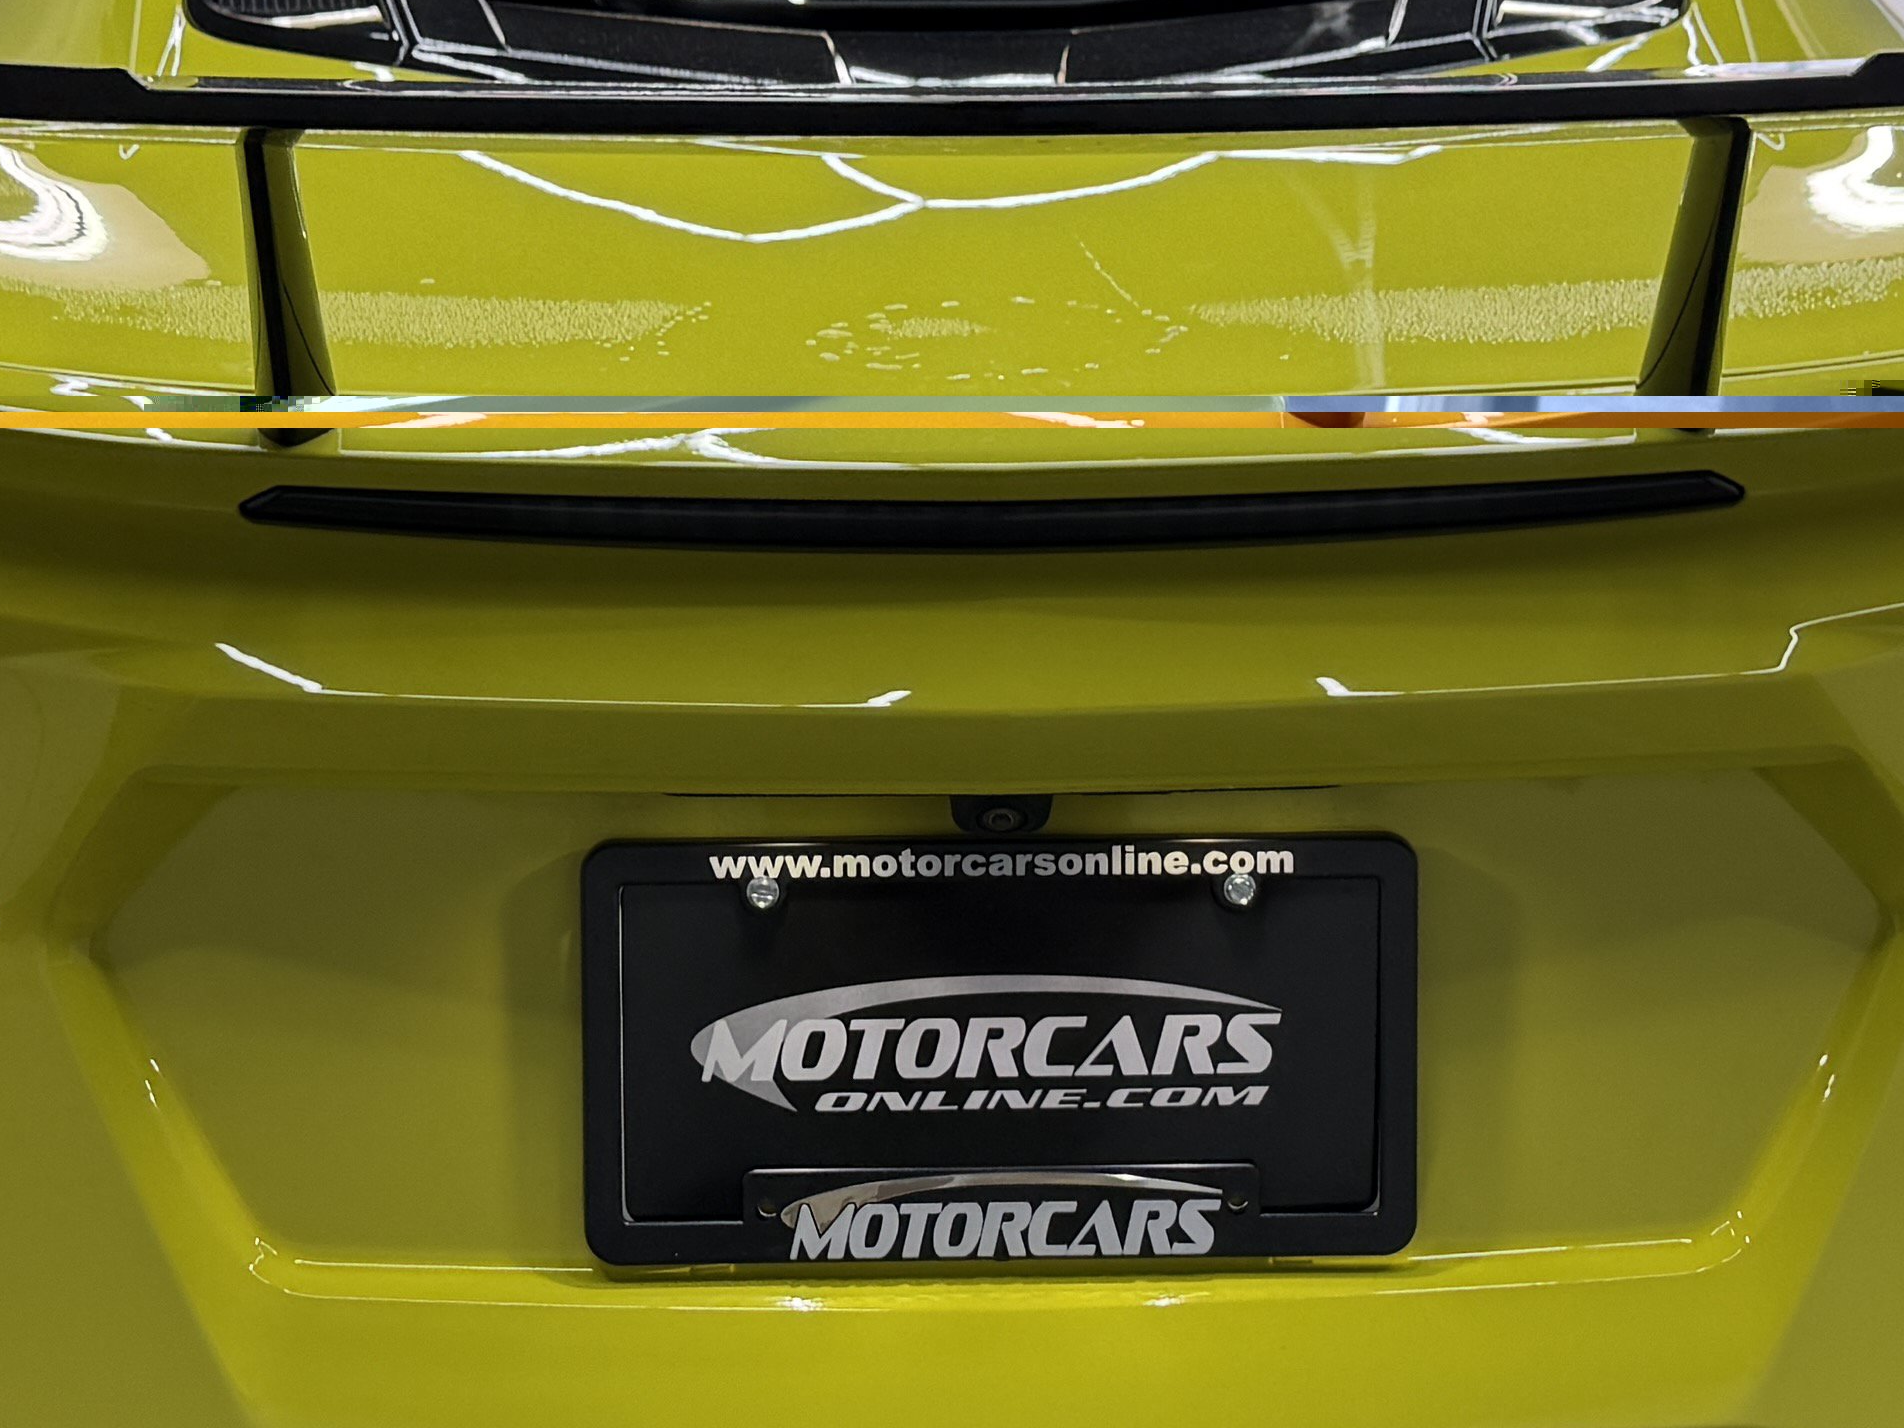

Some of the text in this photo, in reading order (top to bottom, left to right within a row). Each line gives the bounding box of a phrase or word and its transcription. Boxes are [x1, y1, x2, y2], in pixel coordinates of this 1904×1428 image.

[709, 844, 1294, 879] www.motorcarsonline.com
[701, 1012, 1283, 1082] MOTORCARS
[815, 1085, 1270, 1112] ONLINE.COM
[789, 1199, 1222, 1260] MOTORCARS
